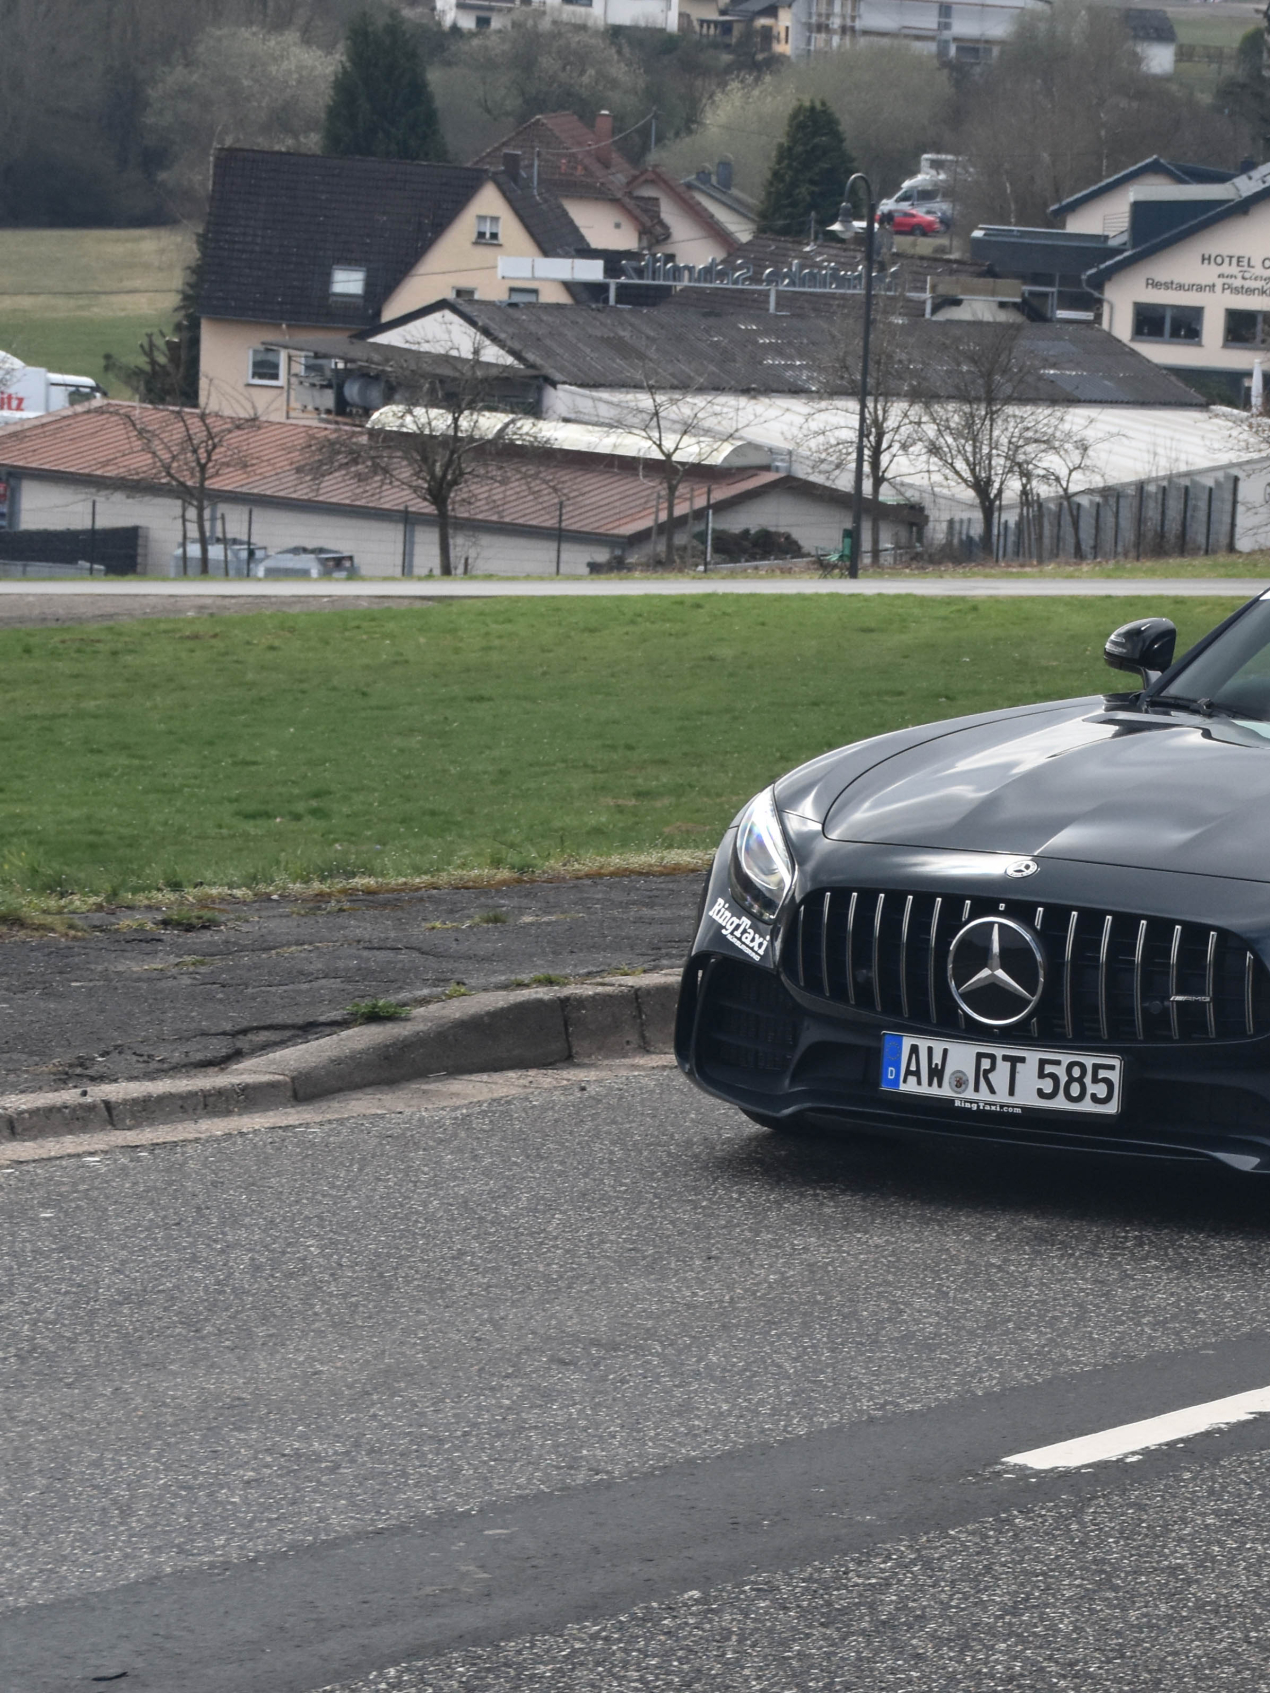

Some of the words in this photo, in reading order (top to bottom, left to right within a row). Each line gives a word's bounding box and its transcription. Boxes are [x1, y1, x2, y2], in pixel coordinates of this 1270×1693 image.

[1201, 253, 1255, 268] HOTEL
[1217, 272, 1238, 280] am
[1145, 277, 1216, 294] Restaurant
[708, 897, 770, 956] RingTaxi
[887, 1067, 896, 1079] D
[902, 1043, 949, 1088] AW
[973, 1051, 1026, 1096] RT
[1036, 1057, 1116, 1105] 585
